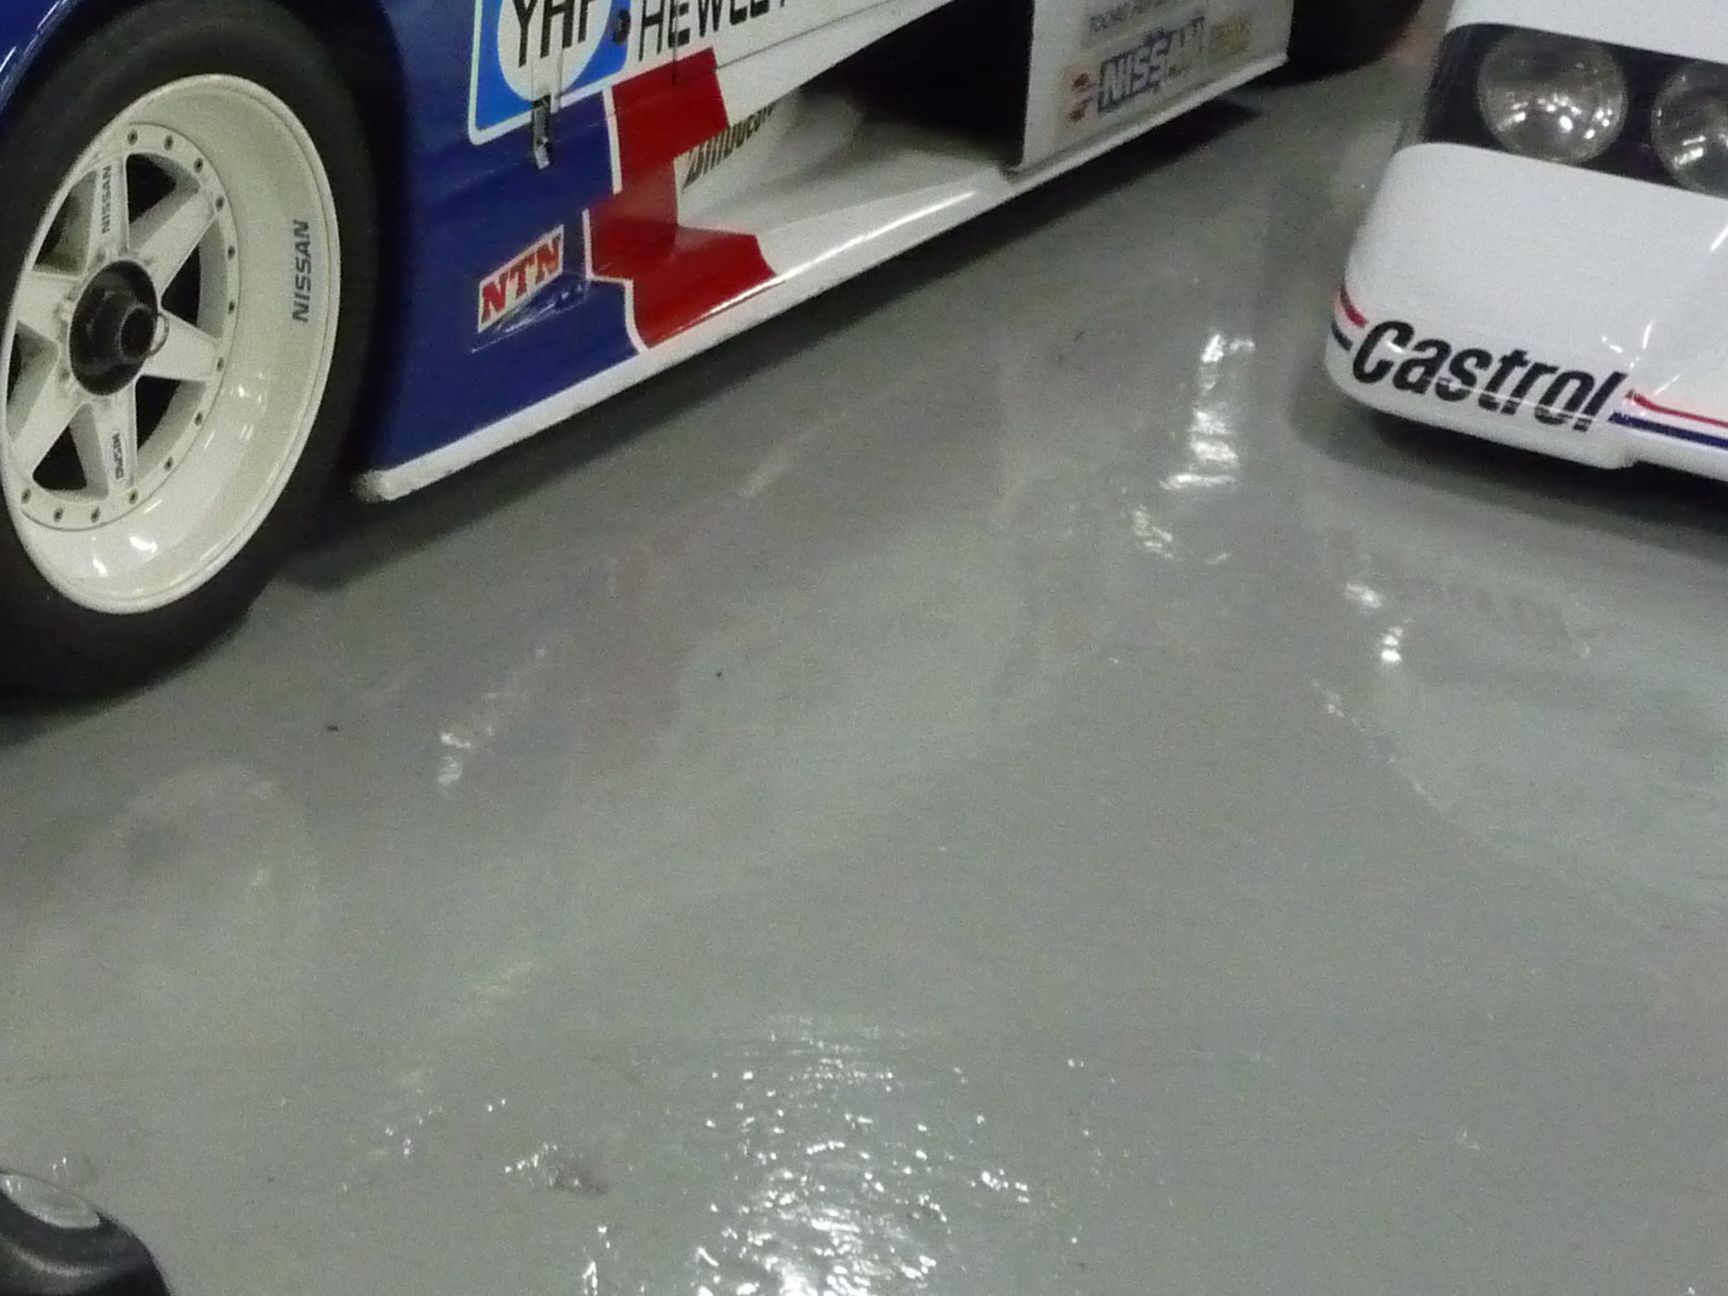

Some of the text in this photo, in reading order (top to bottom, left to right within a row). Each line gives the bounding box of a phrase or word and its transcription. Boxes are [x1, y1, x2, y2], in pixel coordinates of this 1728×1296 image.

[100, 165, 112, 234] NISSAN
[291, 219, 311, 324] NISSAN
[480, 233, 562, 323] NTN
[1352, 318, 1628, 433] Castrol
